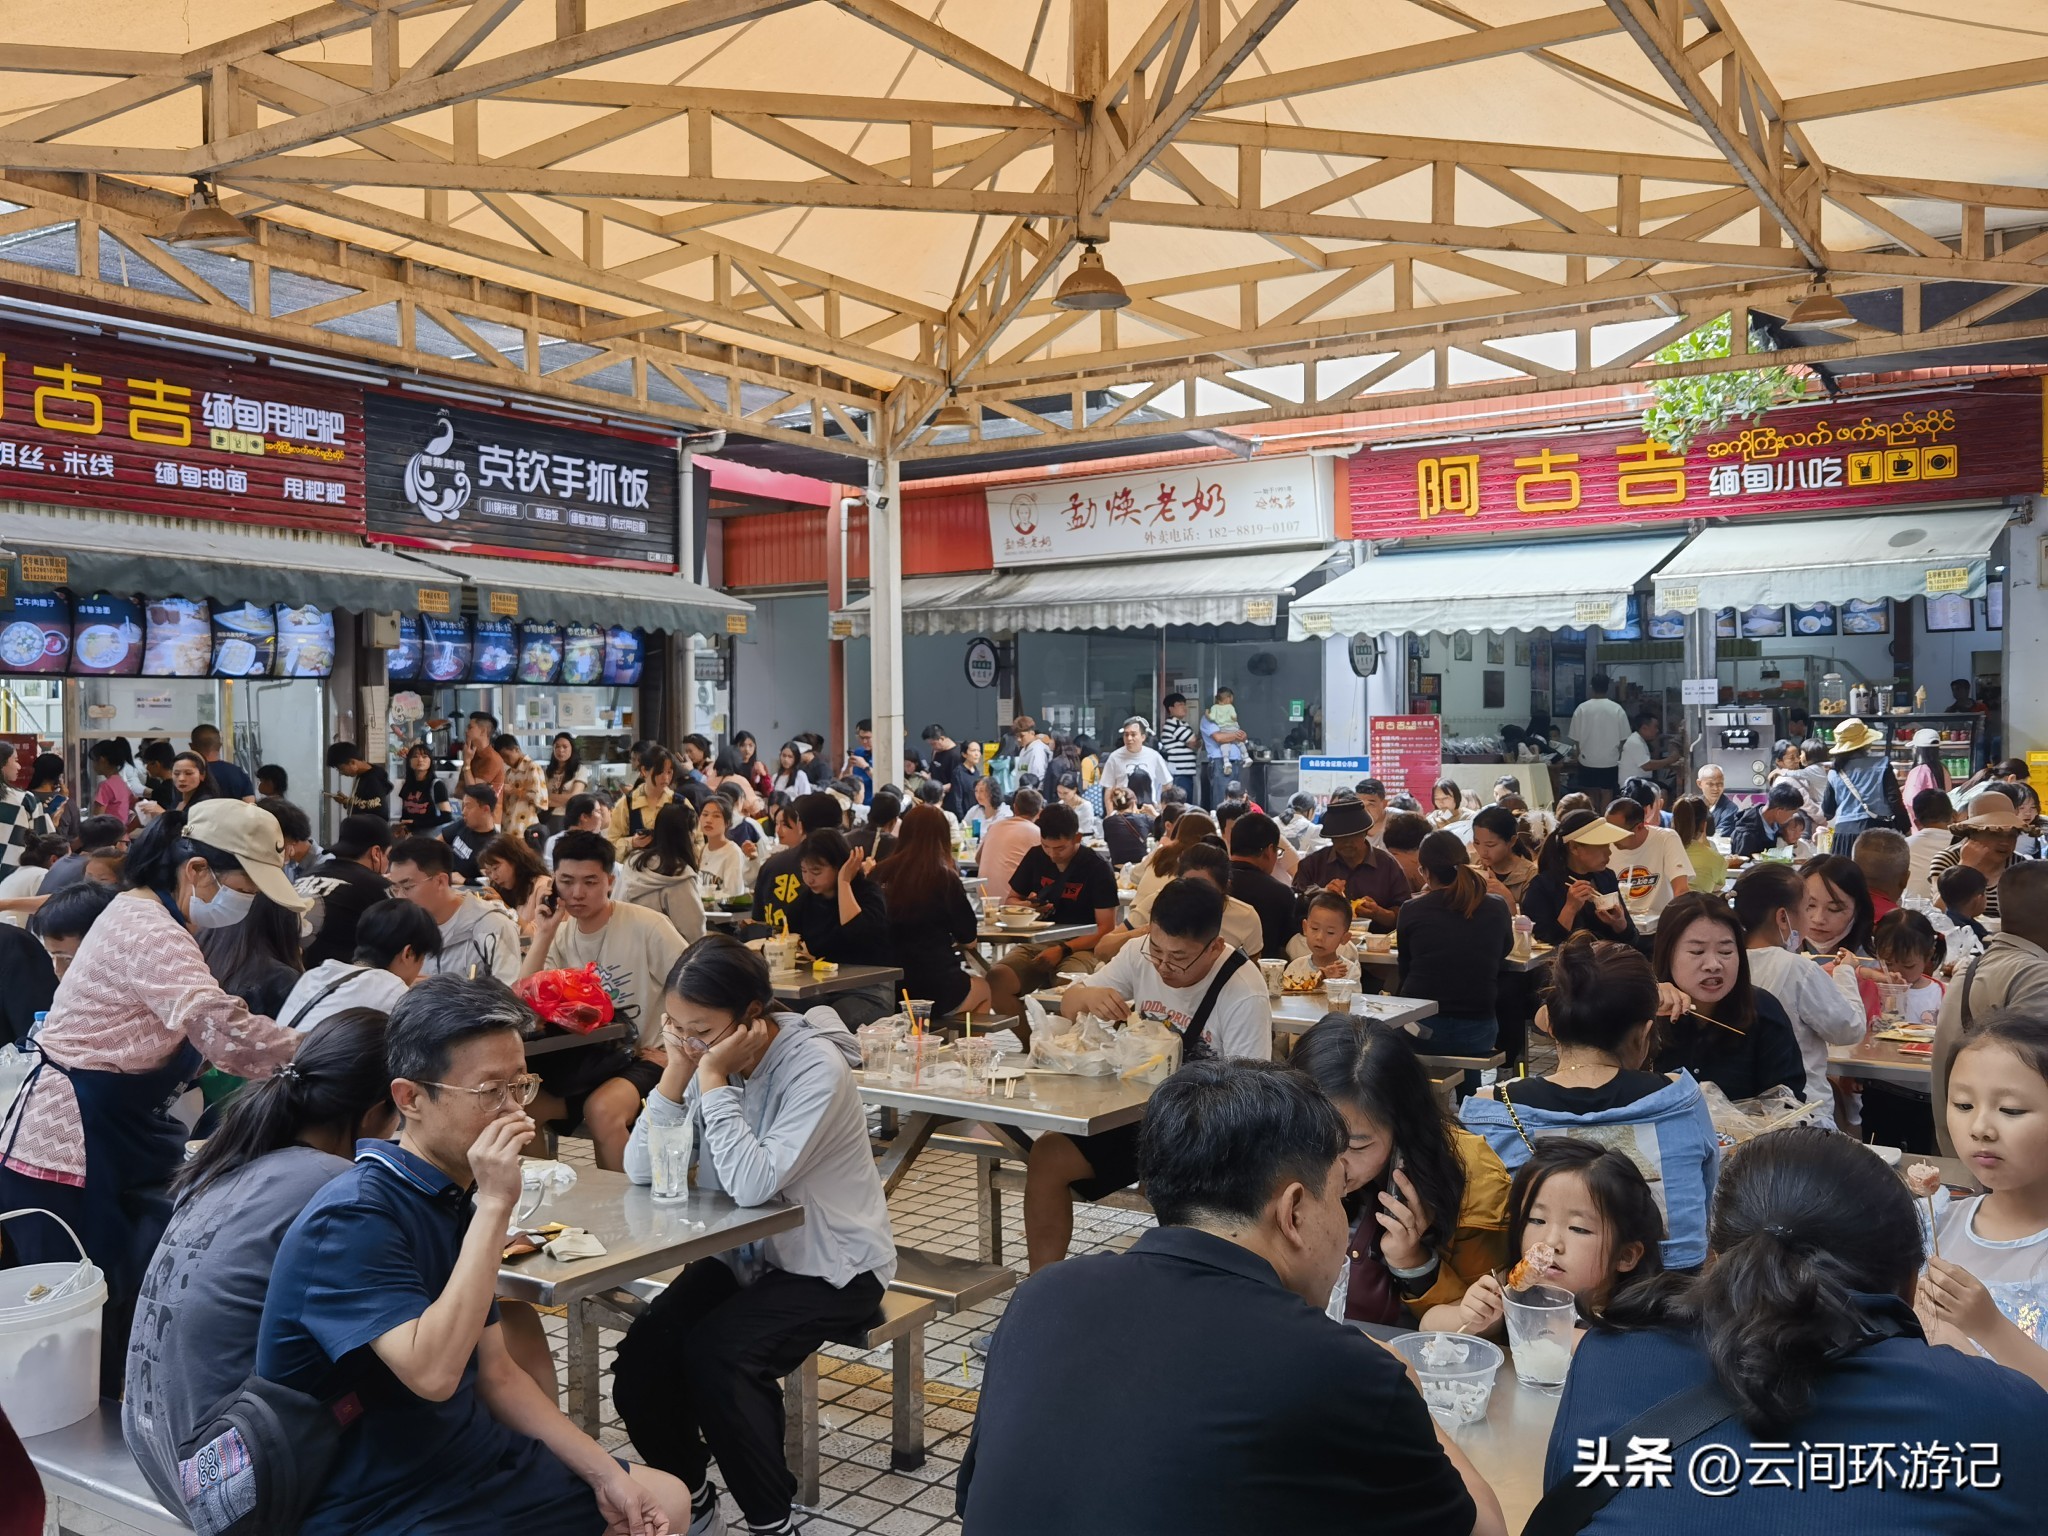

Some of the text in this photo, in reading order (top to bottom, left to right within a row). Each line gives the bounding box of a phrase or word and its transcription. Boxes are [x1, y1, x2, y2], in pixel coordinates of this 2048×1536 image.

[0, 353, 192, 447] 古吉
[202, 392, 345, 445] 缅甸甩粑粑
[155, 461, 248, 493] 缅甸油面
[283, 477, 346, 504] 甩粑粑
[478, 444, 650, 509] 克钦手抓饭
[1417, 438, 1686, 519] 阿古吉
[1709, 456, 1842, 496] 缅甸小吃
[1208, 521, 1300, 539] 182-8819-0107
